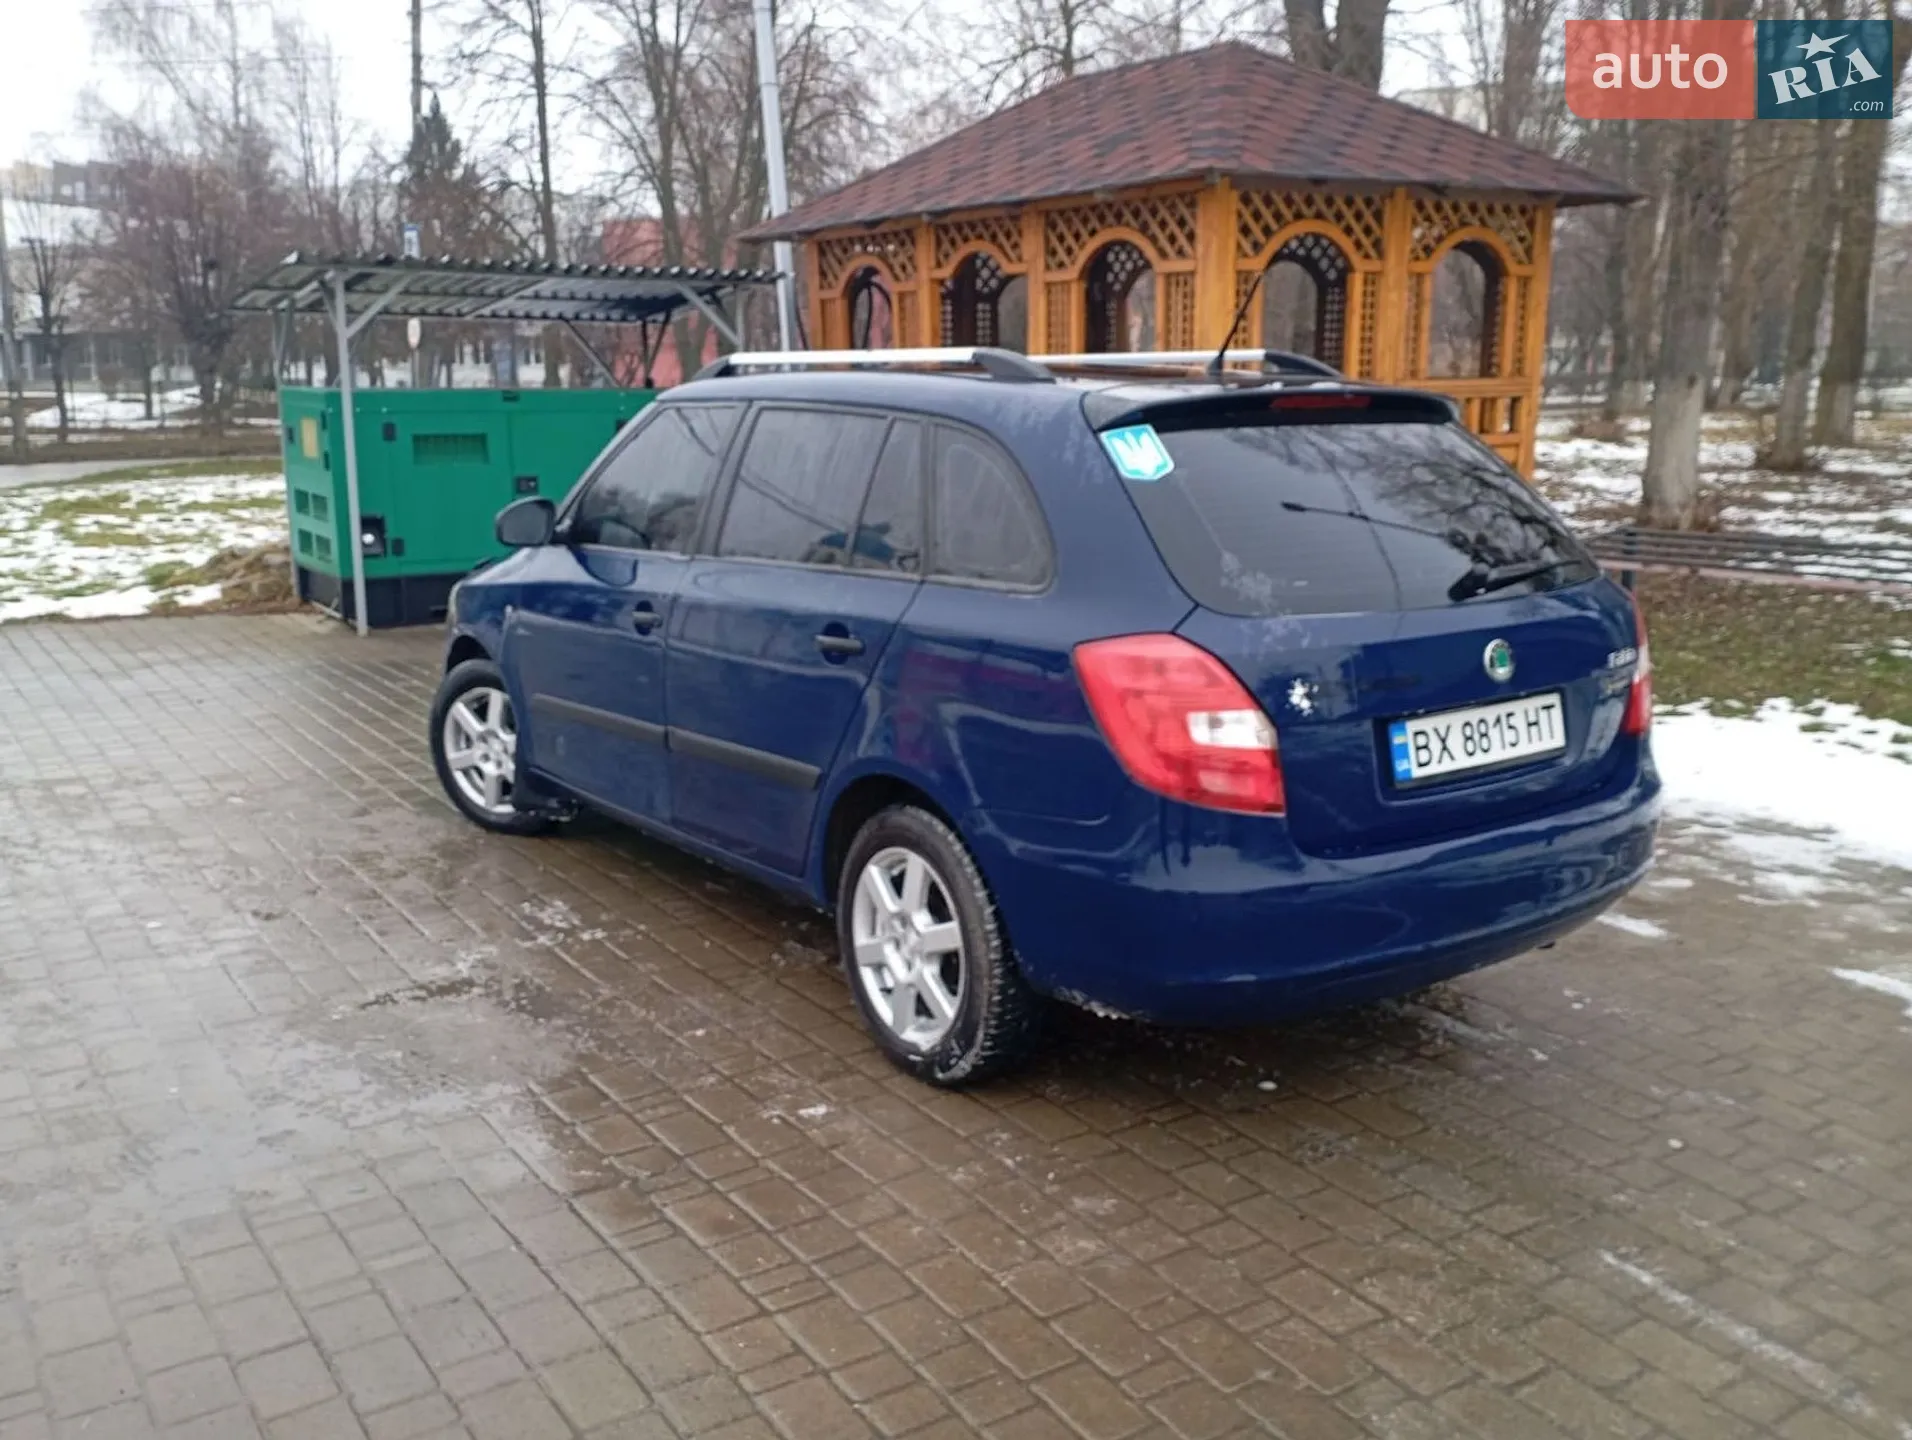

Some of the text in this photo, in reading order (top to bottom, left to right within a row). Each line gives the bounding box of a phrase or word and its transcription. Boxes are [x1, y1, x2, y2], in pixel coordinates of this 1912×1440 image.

[1412, 703, 1557, 769] BX 8815 HT
